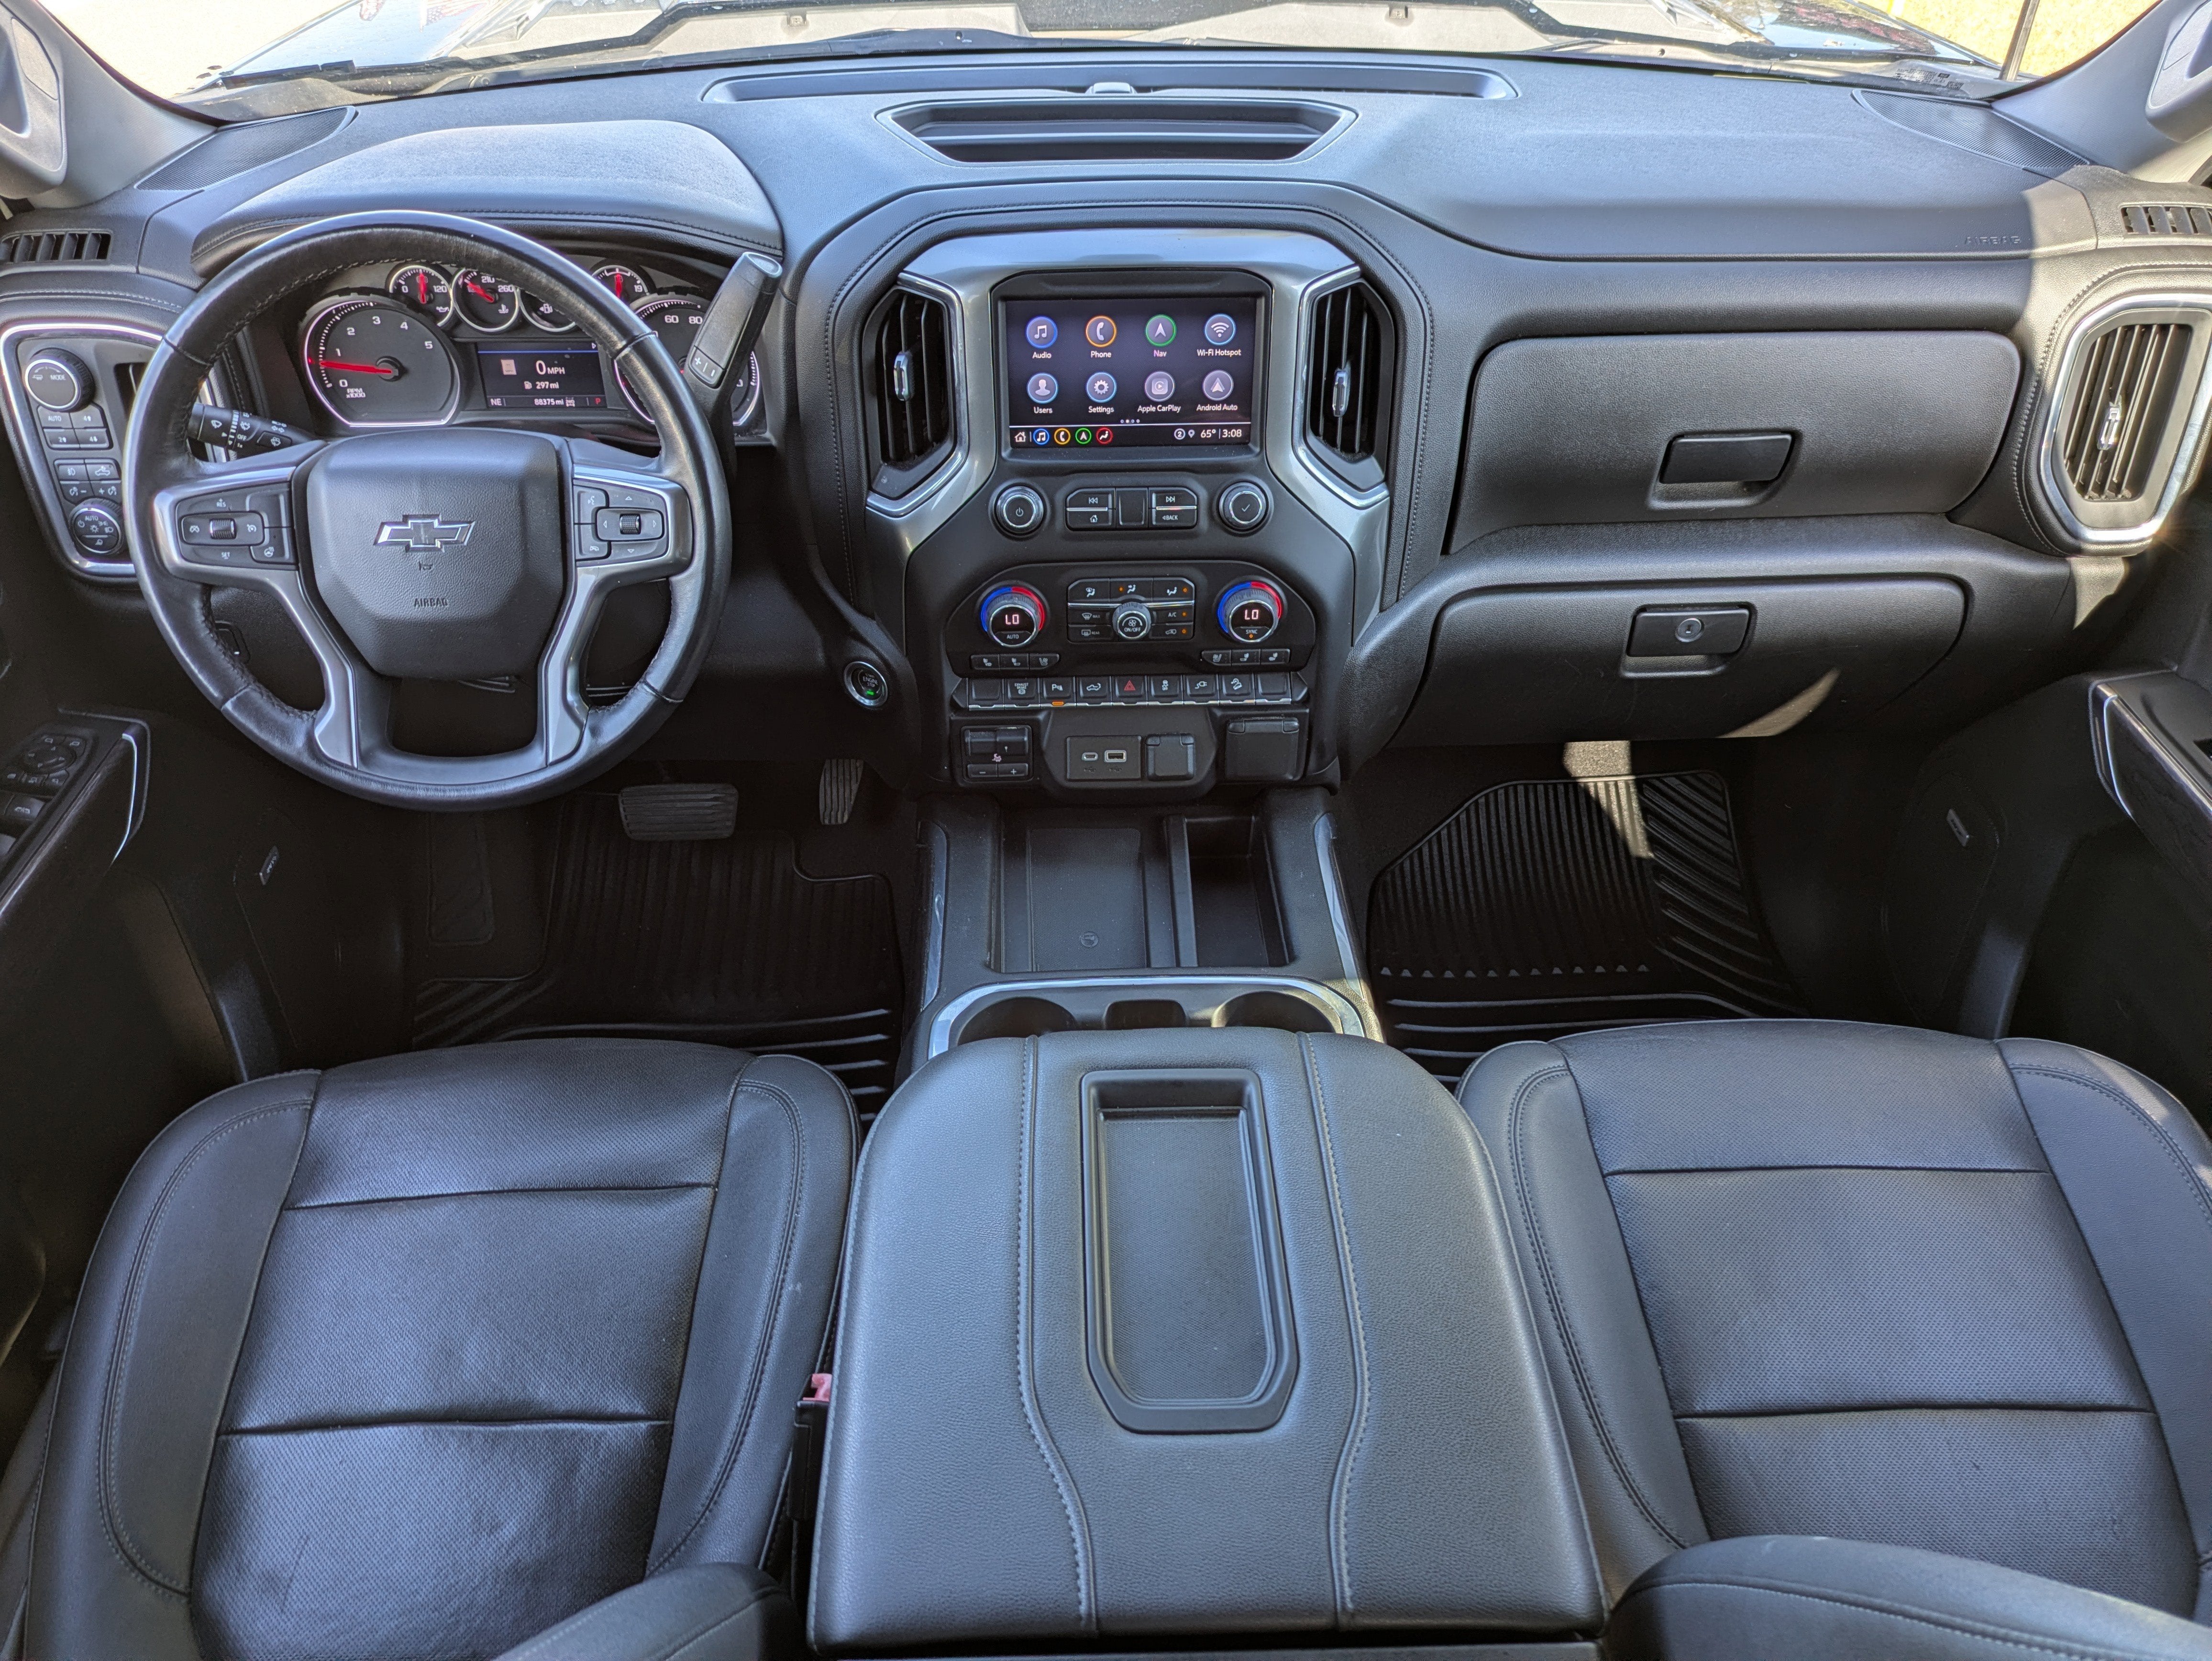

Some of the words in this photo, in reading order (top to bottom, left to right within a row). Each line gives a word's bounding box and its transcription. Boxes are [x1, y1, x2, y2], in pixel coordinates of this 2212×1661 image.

[498, 285, 515, 293] 260
[373, 316, 381, 325] 3
[665, 315, 679, 323] 60
[688, 316, 703, 324] 80
[400, 321, 409, 330] 4
[347, 327, 355, 336] 2
[424, 341, 433, 349] 5
[335, 348, 341, 357] 1
[1215, 349, 1242, 357] Hotspot
[535, 360, 546, 375] 0
[547, 366, 565, 375] MPH
[339, 379, 348, 388] 0
[535, 381, 549, 389] 297
[1088, 406, 1115, 415] Settings
[1137, 405, 1156, 414] Apple
[1157, 404, 1181, 413] CarPlay
[1222, 429, 1242, 438] 3:08
[414, 597, 448, 607] AIRBAG
